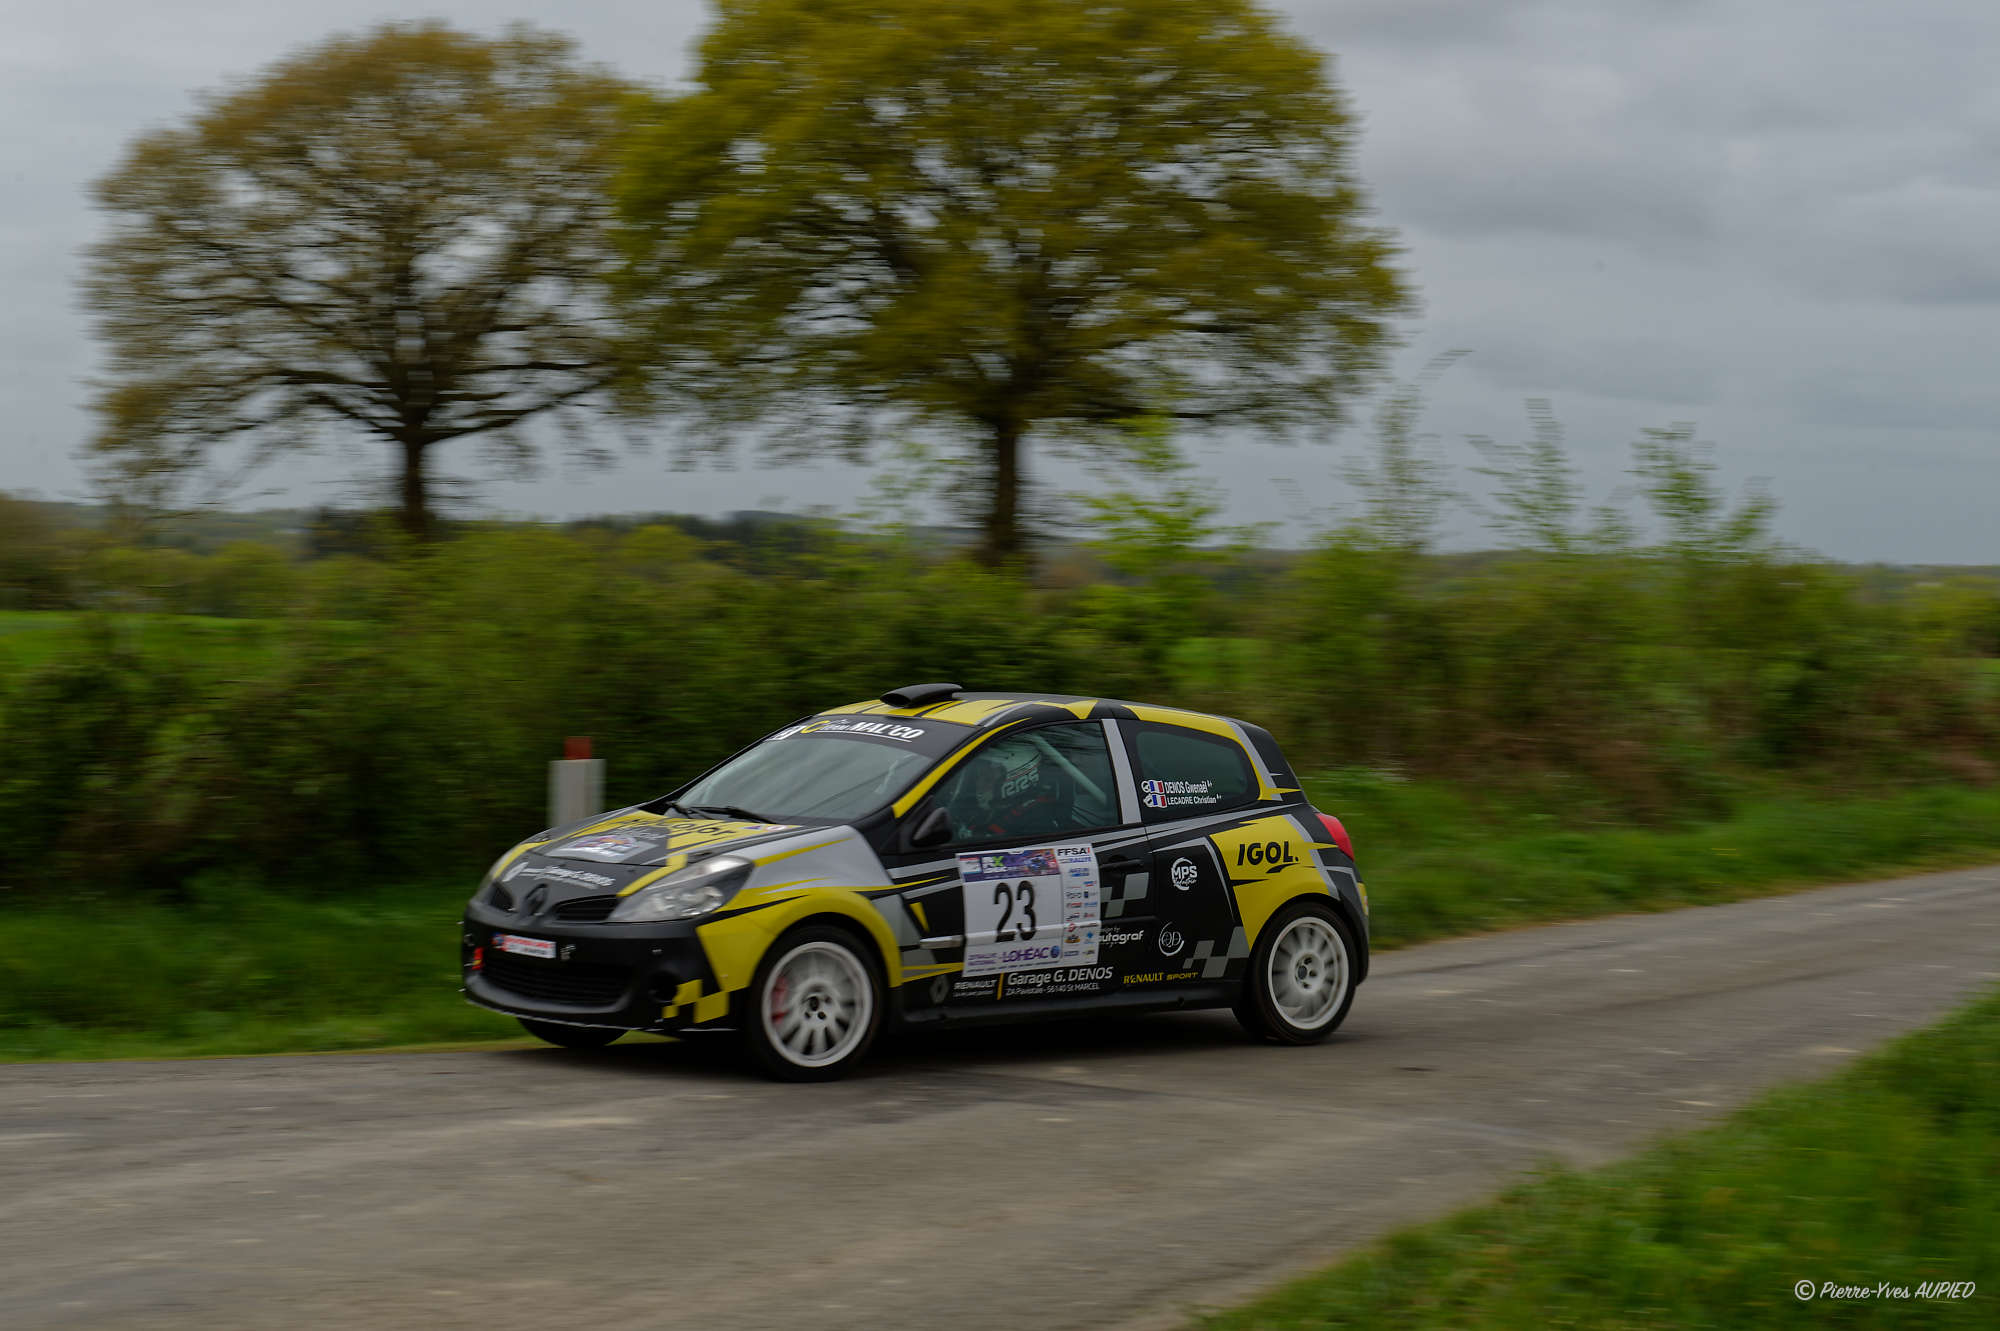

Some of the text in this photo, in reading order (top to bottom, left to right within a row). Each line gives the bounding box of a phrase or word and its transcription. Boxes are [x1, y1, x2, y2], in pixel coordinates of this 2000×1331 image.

[1171, 865, 1198, 880] MPS
[993, 880, 1037, 943] 23
[1002, 946, 1050, 962] LOHÉAC
[1007, 972, 1051, 987] Garage
[1068, 966, 1114, 981] DENOS
[1123, 972, 1164, 985] RENAULT
